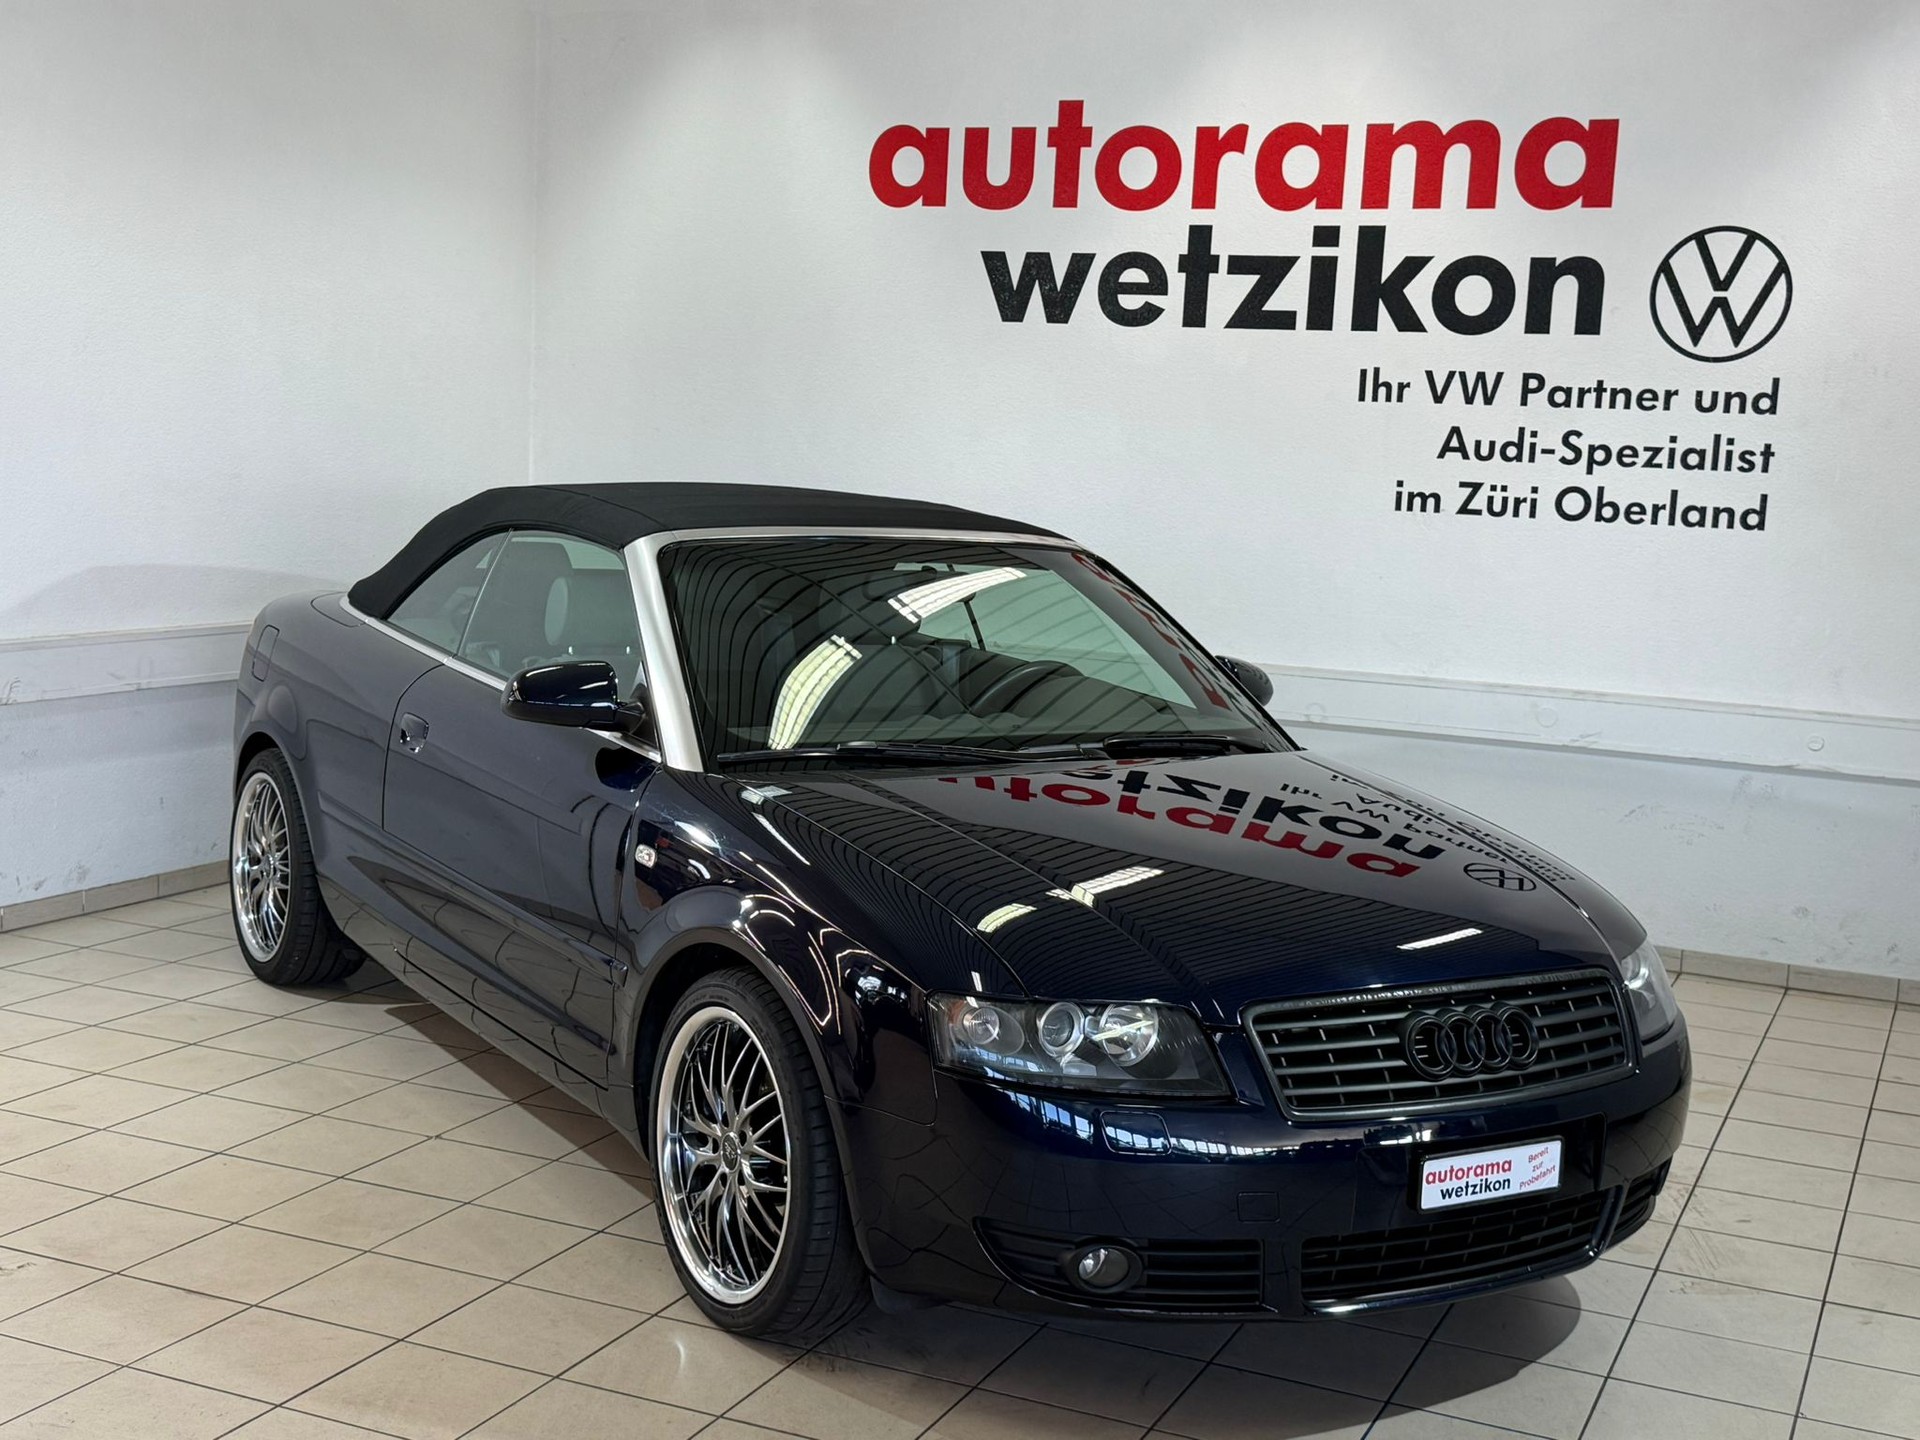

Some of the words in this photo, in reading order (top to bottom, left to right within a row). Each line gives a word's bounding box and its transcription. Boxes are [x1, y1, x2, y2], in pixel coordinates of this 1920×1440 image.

[869, 100, 1619, 212] autorama
[981, 225, 1605, 336] wetzikon
[1359, 368, 1411, 405] Ihr
[1425, 370, 1506, 406] VW
[1521, 372, 1679, 412] Partner
[1694, 377, 1781, 416] und
[1436, 425, 1777, 476] Audi-Spezialist
[1394, 486, 1442, 514] im
[1455, 481, 1538, 520] Züri
[1554, 487, 1769, 532] Oberland
[1425, 1159, 1512, 1185] autorama
[1528, 1146, 1549, 1163] Bereit
[1532, 1160, 1544, 1172] zur
[1440, 1177, 1511, 1200] wetzikon
[1519, 1164, 1556, 1191] Probefahrt
